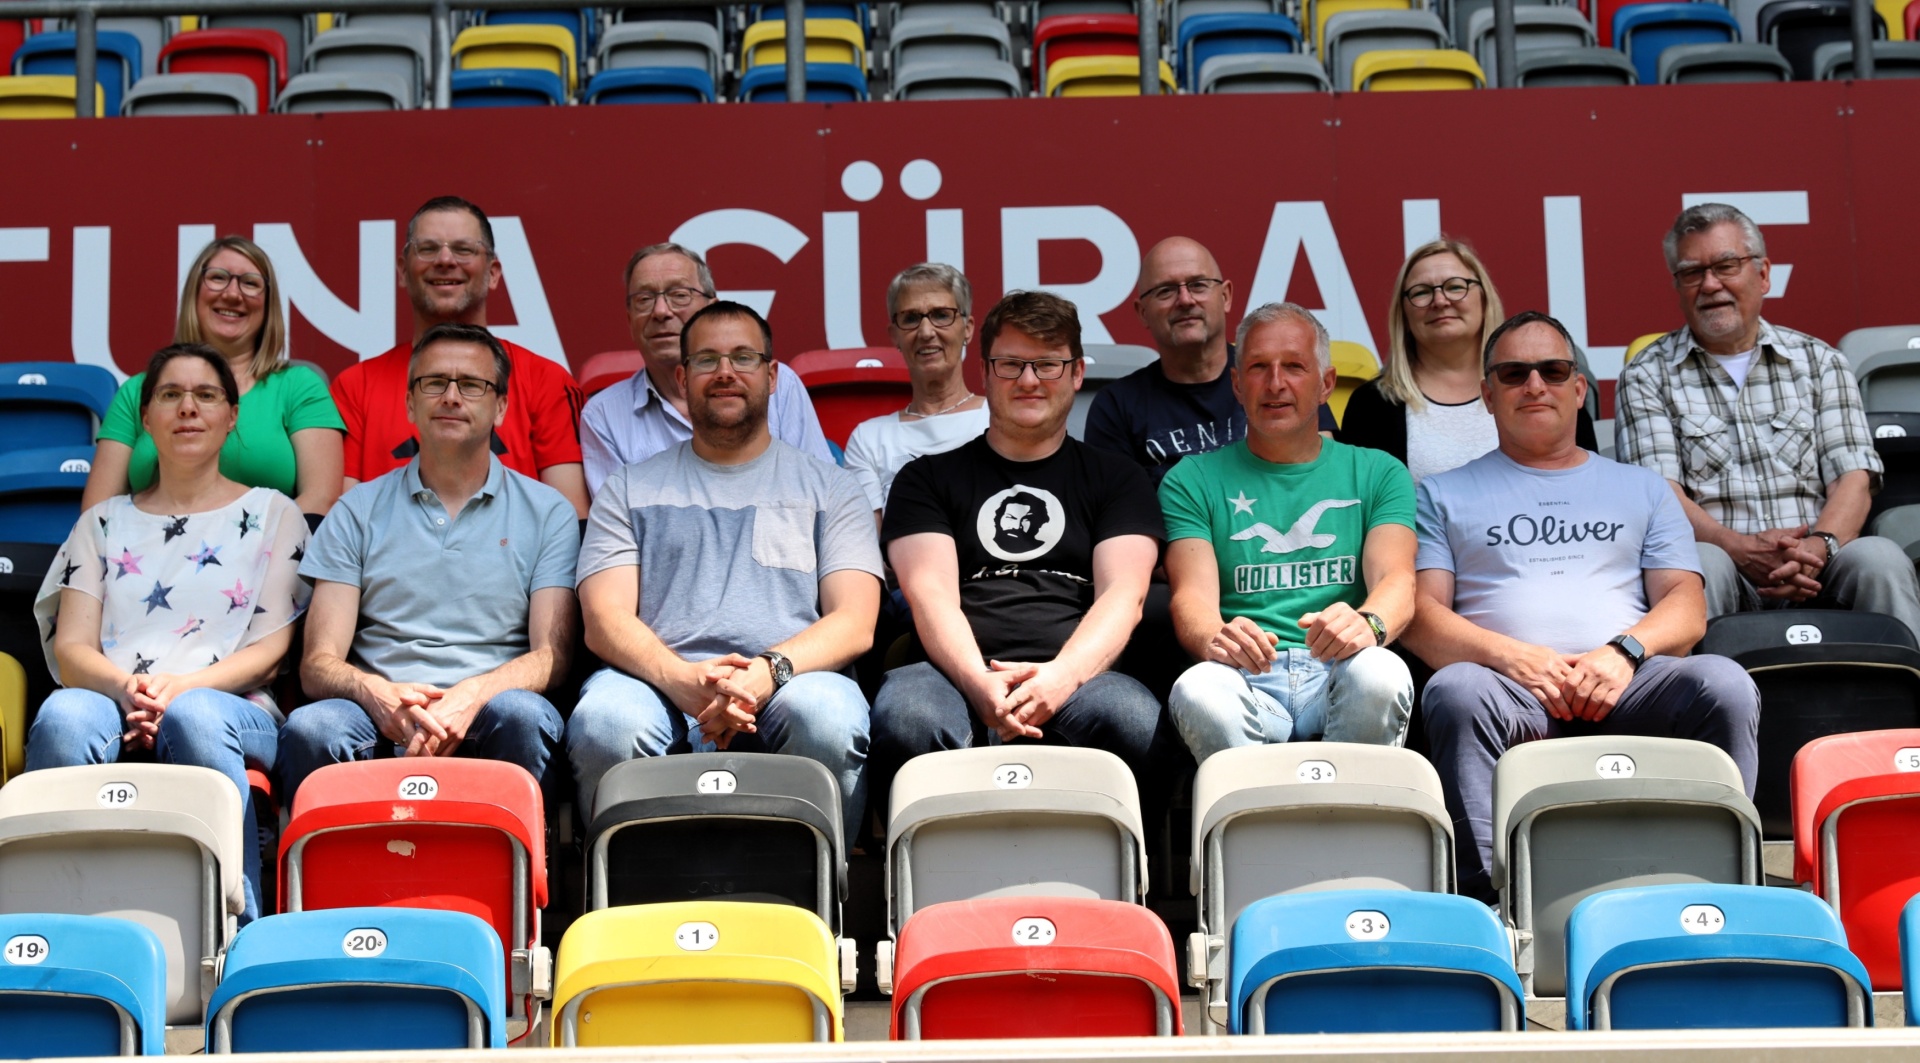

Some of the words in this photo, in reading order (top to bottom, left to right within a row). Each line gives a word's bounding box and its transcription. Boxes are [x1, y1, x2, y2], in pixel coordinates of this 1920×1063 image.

[1486, 513, 1625, 547] s.Oliver
[1528, 555, 1566, 563] ESTABLISHED
[1237, 559, 1353, 592] HOLLISTER
[1800, 630, 1809, 642] 5
[1610, 760, 1621, 775] 4
[1910, 754, 1920, 769] 5
[1007, 770, 1018, 784] 2
[1310, 767, 1322, 781] 3
[406, 781, 429, 796] 20
[712, 777, 720, 791] 1
[107, 789, 128, 803] 19
[1362, 918, 1373, 933] 3
[1697, 912, 1708, 927] 4
[692, 929, 700, 944] 1
[1028, 925, 1039, 940] 2
[15, 942, 39, 958] 19
[352, 935, 377, 951] 20
